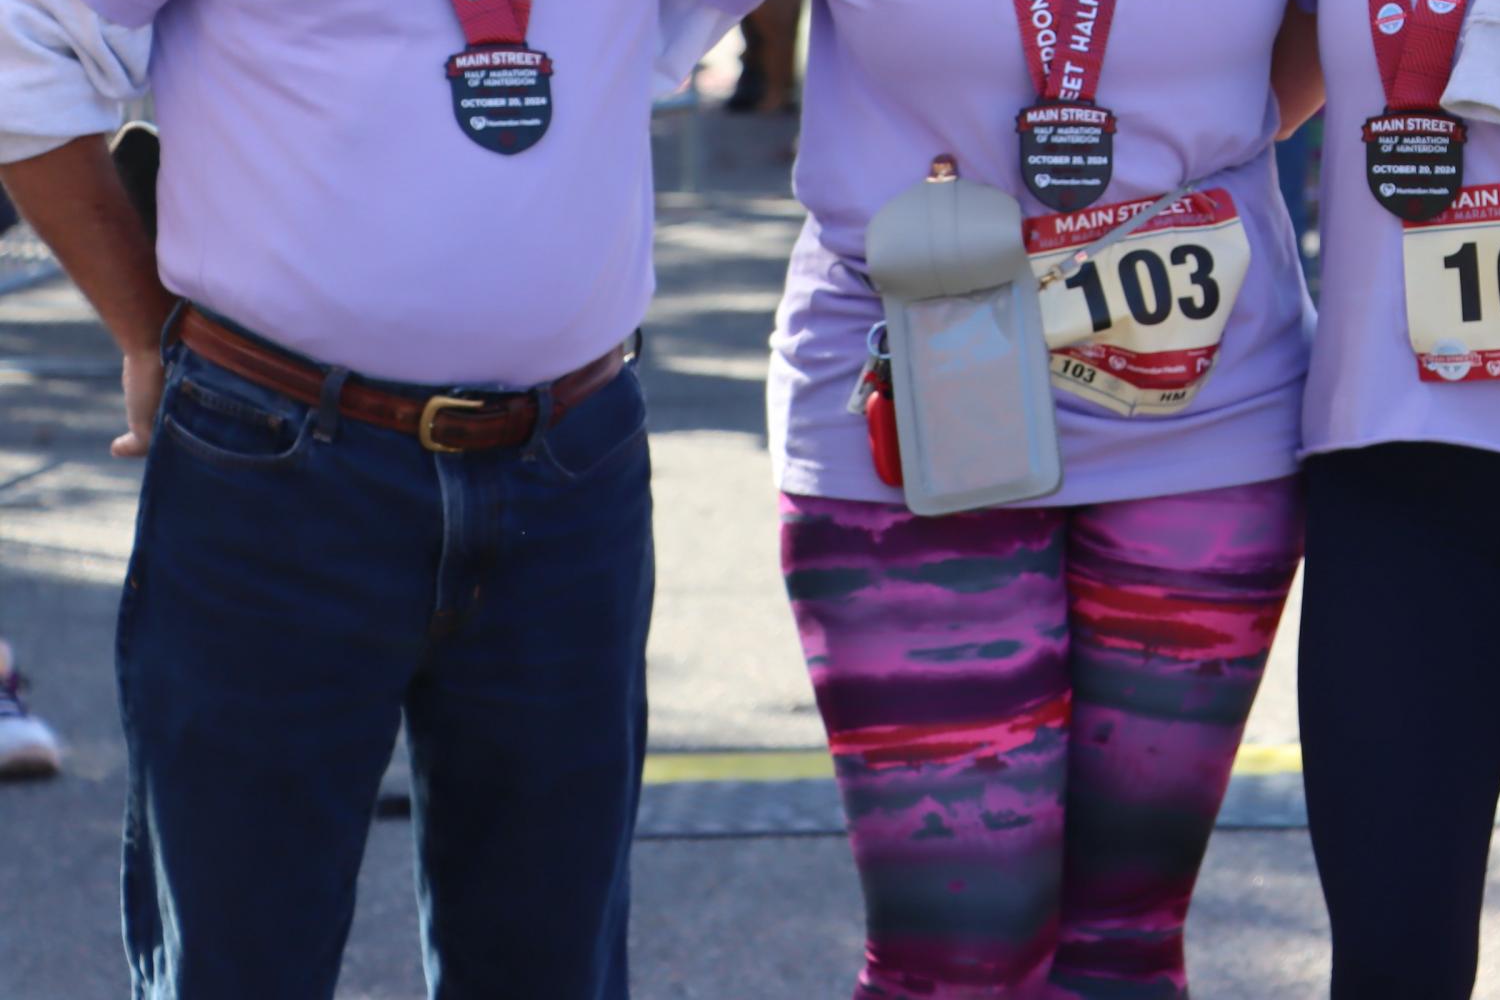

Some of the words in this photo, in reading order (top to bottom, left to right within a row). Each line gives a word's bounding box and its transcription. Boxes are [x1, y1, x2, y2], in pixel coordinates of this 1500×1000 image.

[456, 53, 490, 68] MAIN
[491, 51, 542, 66] STREET
[461, 98, 506, 108] OCTOBER
[1027, 109, 1059, 122] MAIN
[1061, 108, 1107, 122] STREET
[1371, 119, 1404, 133] MAIN
[1406, 118, 1455, 132] STREET
[1378, 136, 1399, 144] HALF
[1403, 136, 1449, 144] MARATHON
[1381, 145, 1393, 153] OF
[1396, 145, 1447, 153] HUNTERDON
[1028, 155, 1071, 165] OCTOBER
[1372, 165, 1417, 174] OCTOBER
[1418, 165, 1432, 175] 20,
[1434, 165, 1456, 175] 2024
[1055, 208, 1114, 234] MAIN
[1066, 243, 1221, 334] 103
[1062, 359, 1097, 384] 103
[1160, 390, 1187, 403] HM
